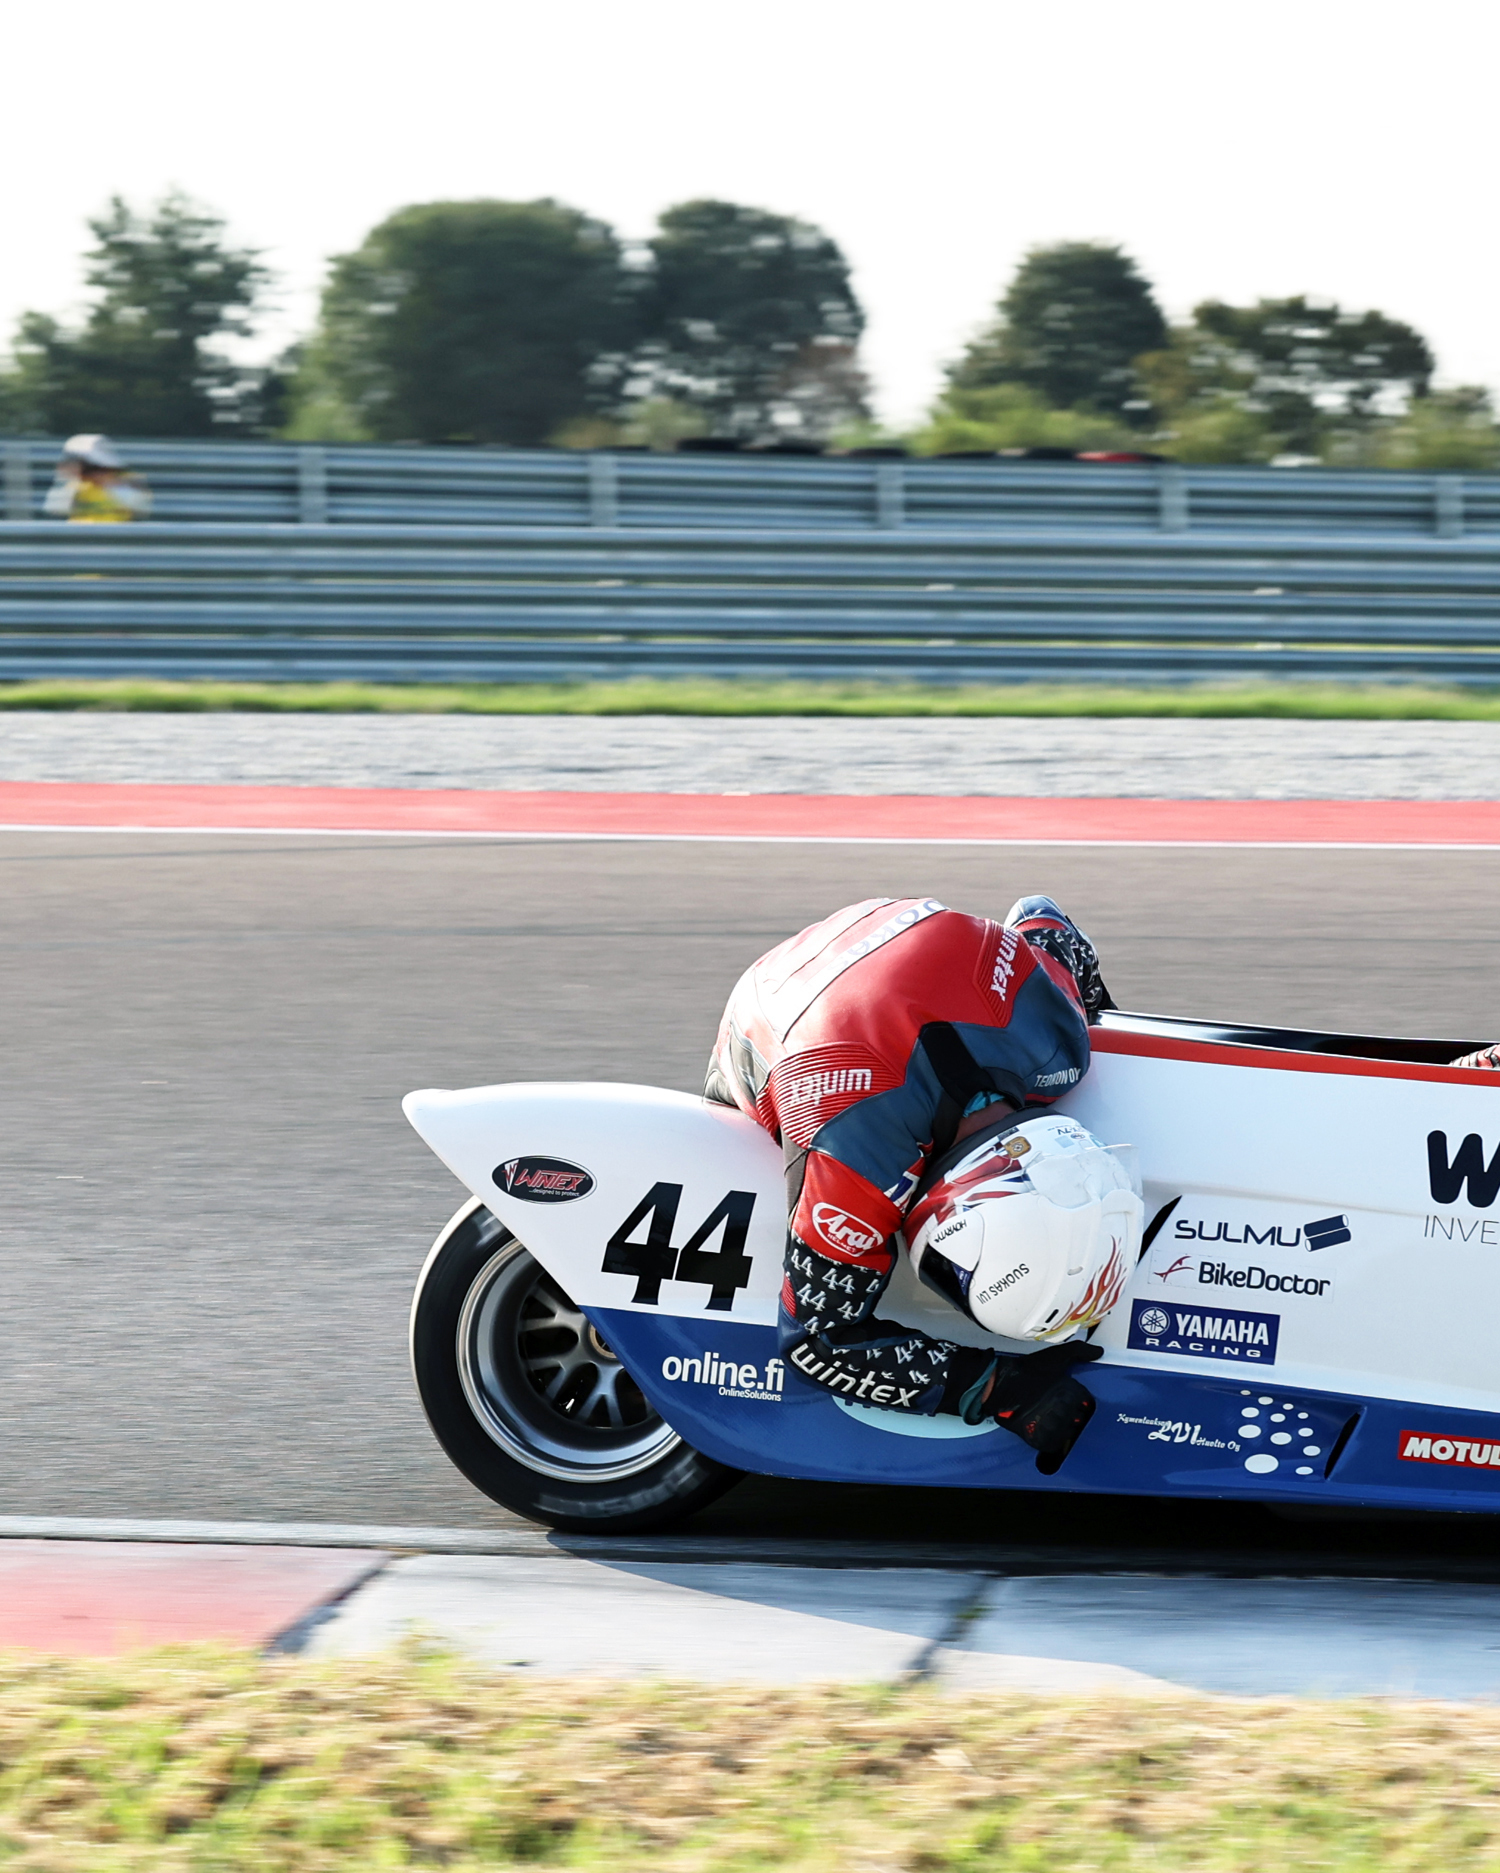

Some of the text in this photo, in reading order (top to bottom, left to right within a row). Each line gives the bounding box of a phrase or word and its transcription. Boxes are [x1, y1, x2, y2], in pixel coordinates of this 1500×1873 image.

[990, 927, 1020, 1002] wintex
[790, 1068, 873, 1106] wintex
[1068, 1067, 1081, 1083] OY
[514, 1168, 587, 1191] WINTEX
[601, 1181, 758, 1312] 44
[814, 1212, 881, 1251] Arai
[1174, 1219, 1301, 1248] SULMU
[791, 1248, 814, 1279] 44
[1198, 1260, 1331, 1296] BikeDoctor
[822, 1267, 856, 1295] 44
[989, 1263, 1031, 1298] SUOKAS
[796, 1282, 828, 1312] 44
[975, 1289, 992, 1305] LVI
[1175, 1312, 1270, 1346] YAMAHA
[1145, 1336, 1262, 1358] RACING
[661, 1351, 785, 1393] online.fi
[790, 1342, 920, 1408] wintex
[1148, 1420, 1202, 1446] LVI
[1227, 1440, 1241, 1453] Oy
